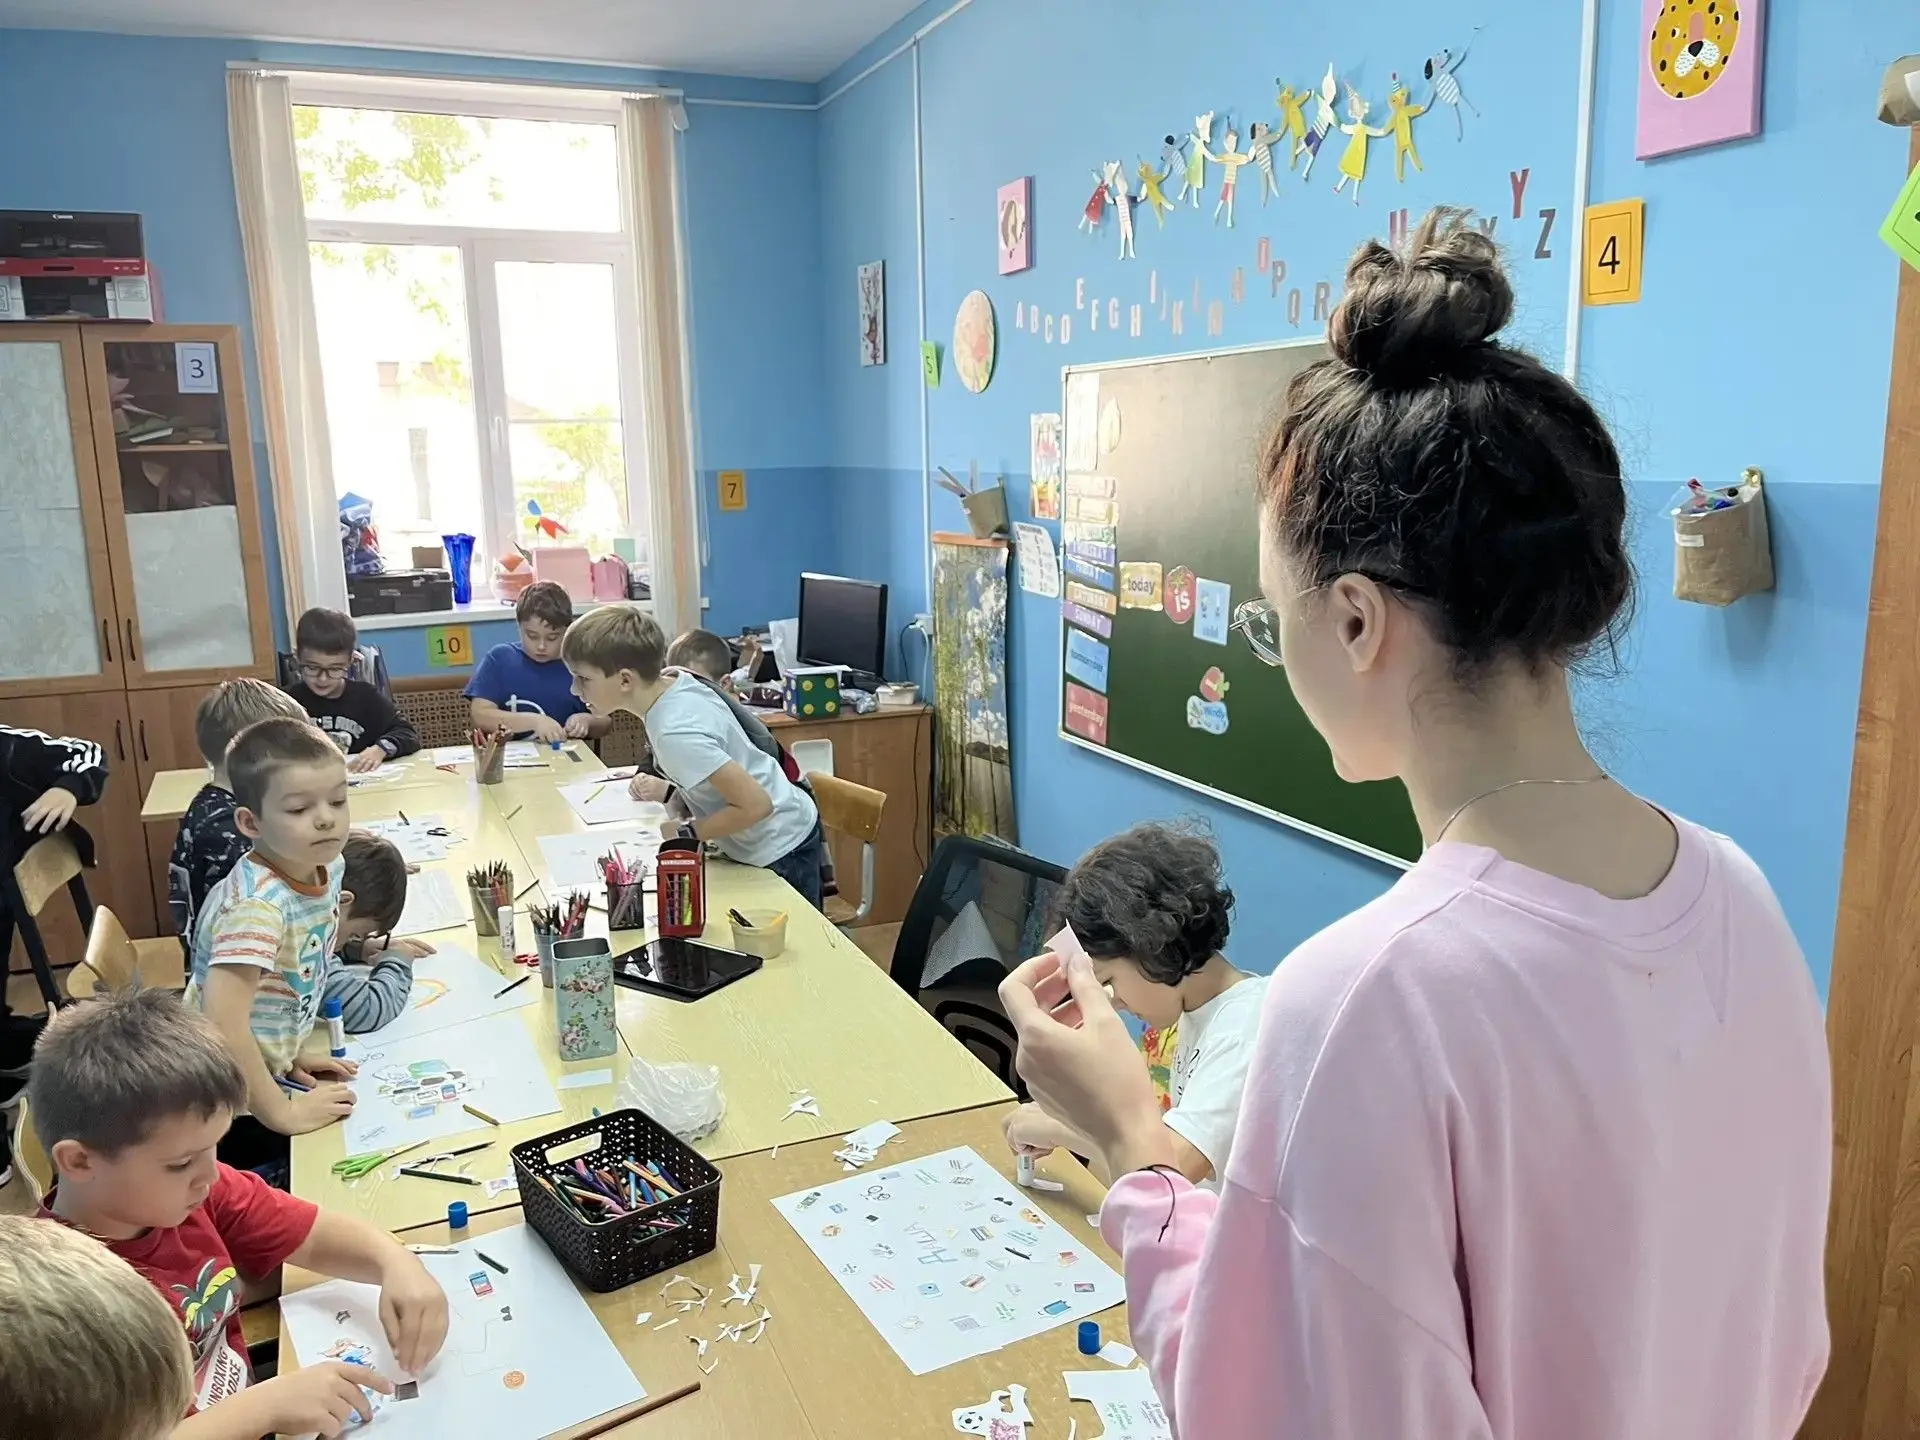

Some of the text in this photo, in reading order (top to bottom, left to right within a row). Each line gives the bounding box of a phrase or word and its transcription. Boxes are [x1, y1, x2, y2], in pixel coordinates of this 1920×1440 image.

[1016, 300, 1023, 328] A
[1030, 305, 1039, 333] B
[1045, 314, 1053, 343] C
[1060, 314, 1070, 344] D
[1076, 277, 1085, 310] E
[1091, 299, 1099, 331] F
[1108, 297, 1119, 329] G
[1130, 304, 1141, 337] H
[1150, 270, 1156, 304] I
[1172, 300, 1183, 335] K
[1272, 260, 1286, 298] P
[1288, 288, 1300, 328] Q
[1314, 282, 1330, 320] R
[1510, 168, 1530, 218] Y
[1534, 208, 1556, 259] Z
[1597, 235, 1620, 275] 4
[189, 358, 204, 379] 3
[727, 483, 737, 499] 7
[1128, 576, 1155, 595] today
[1174, 589, 1191, 613] is
[436, 637, 461, 655] 10
